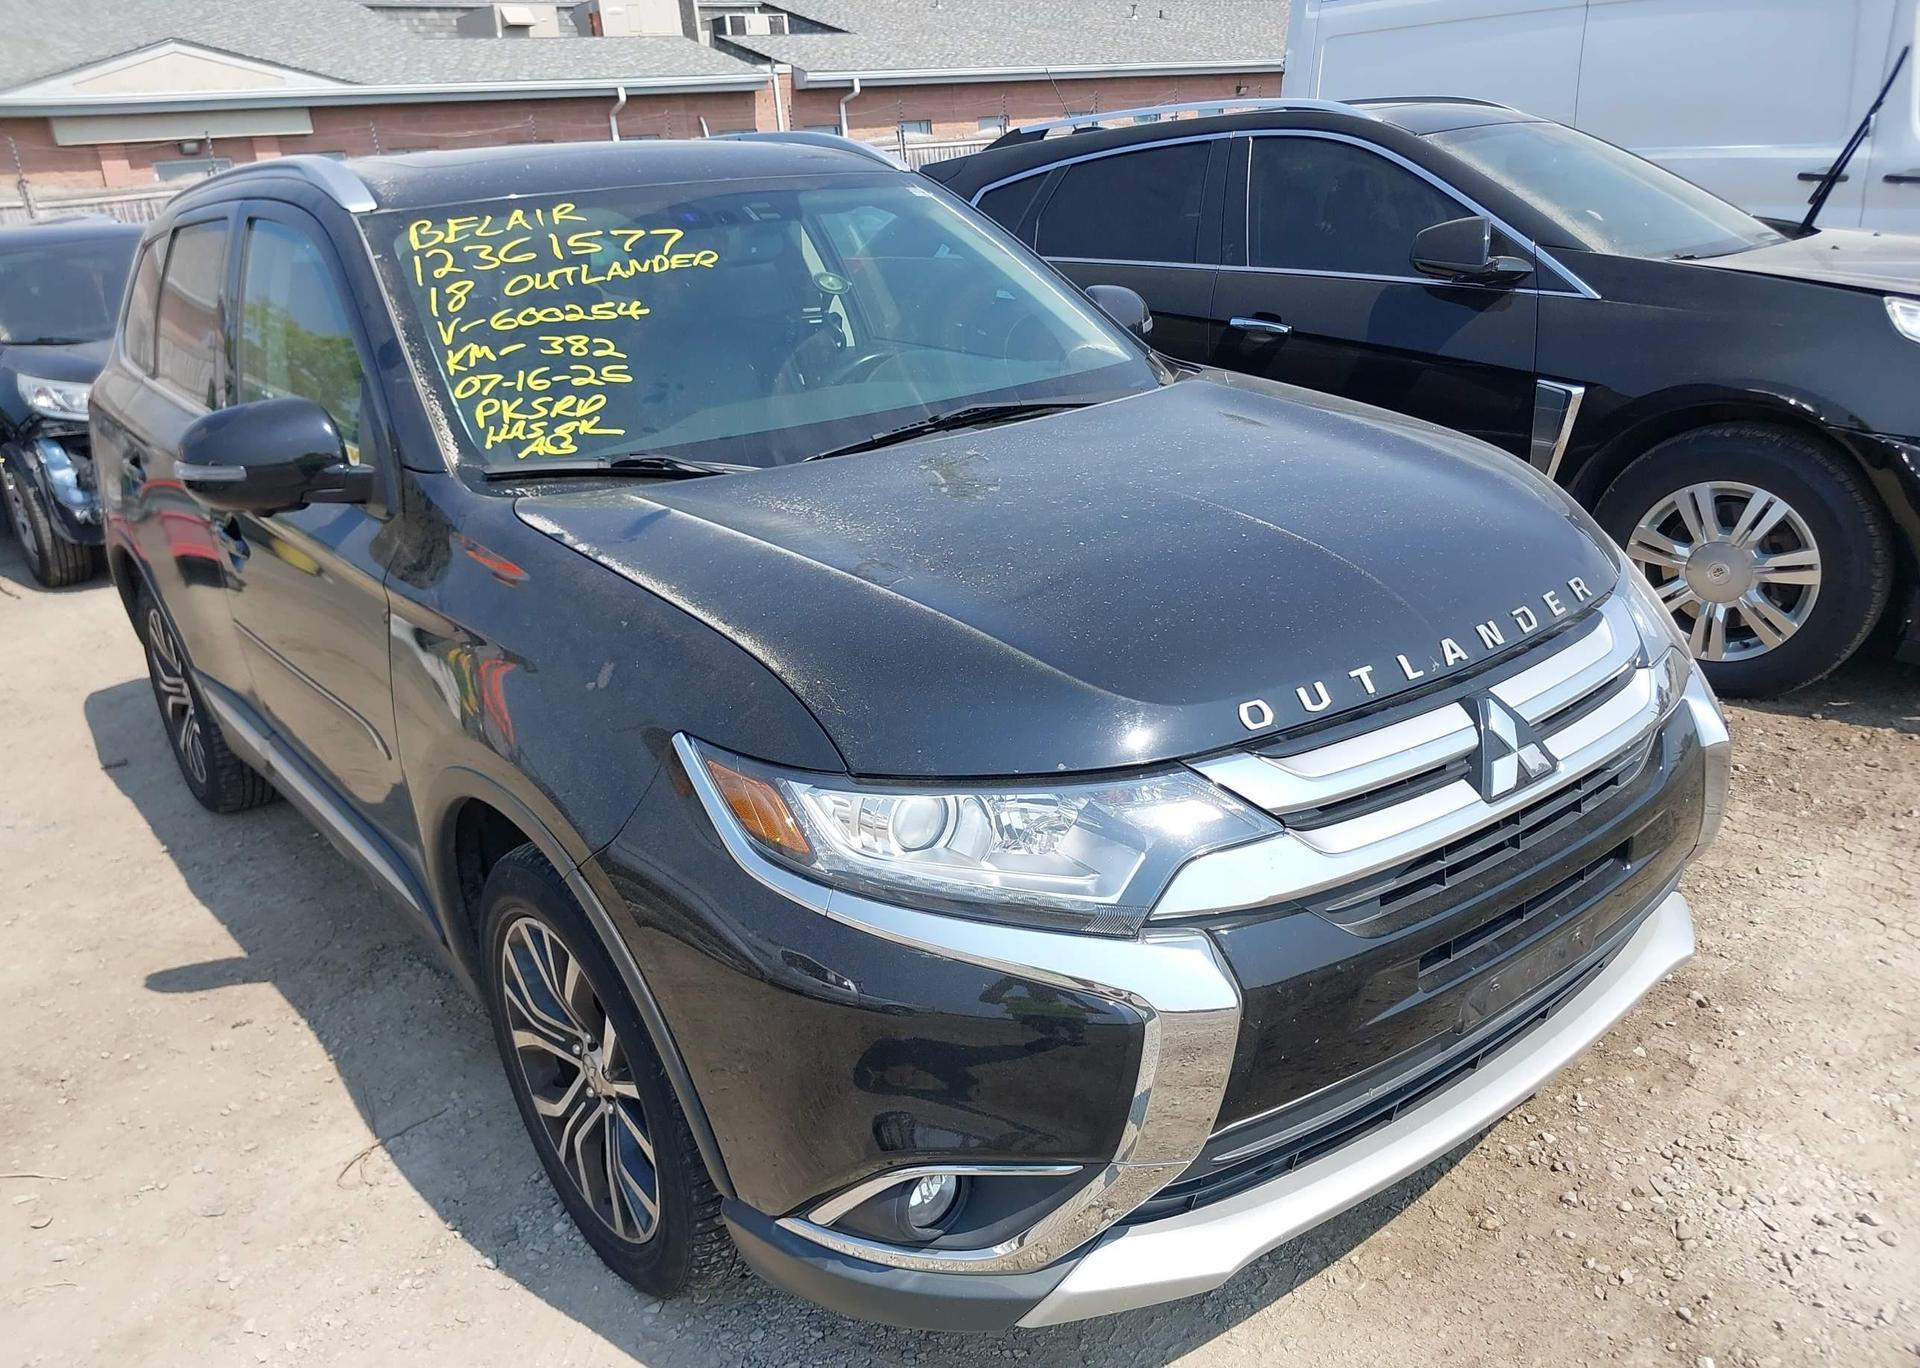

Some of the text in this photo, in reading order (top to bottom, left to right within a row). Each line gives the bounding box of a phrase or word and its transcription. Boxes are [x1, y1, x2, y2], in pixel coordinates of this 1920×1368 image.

[408, 203, 587, 250] BELAIR
[431, 249, 719, 317] 18 OUTLANDER
[538, 334, 627, 359] 382
[454, 364, 633, 399] 07-16-25
[1238, 576, 1593, 731] OUTLANDER
